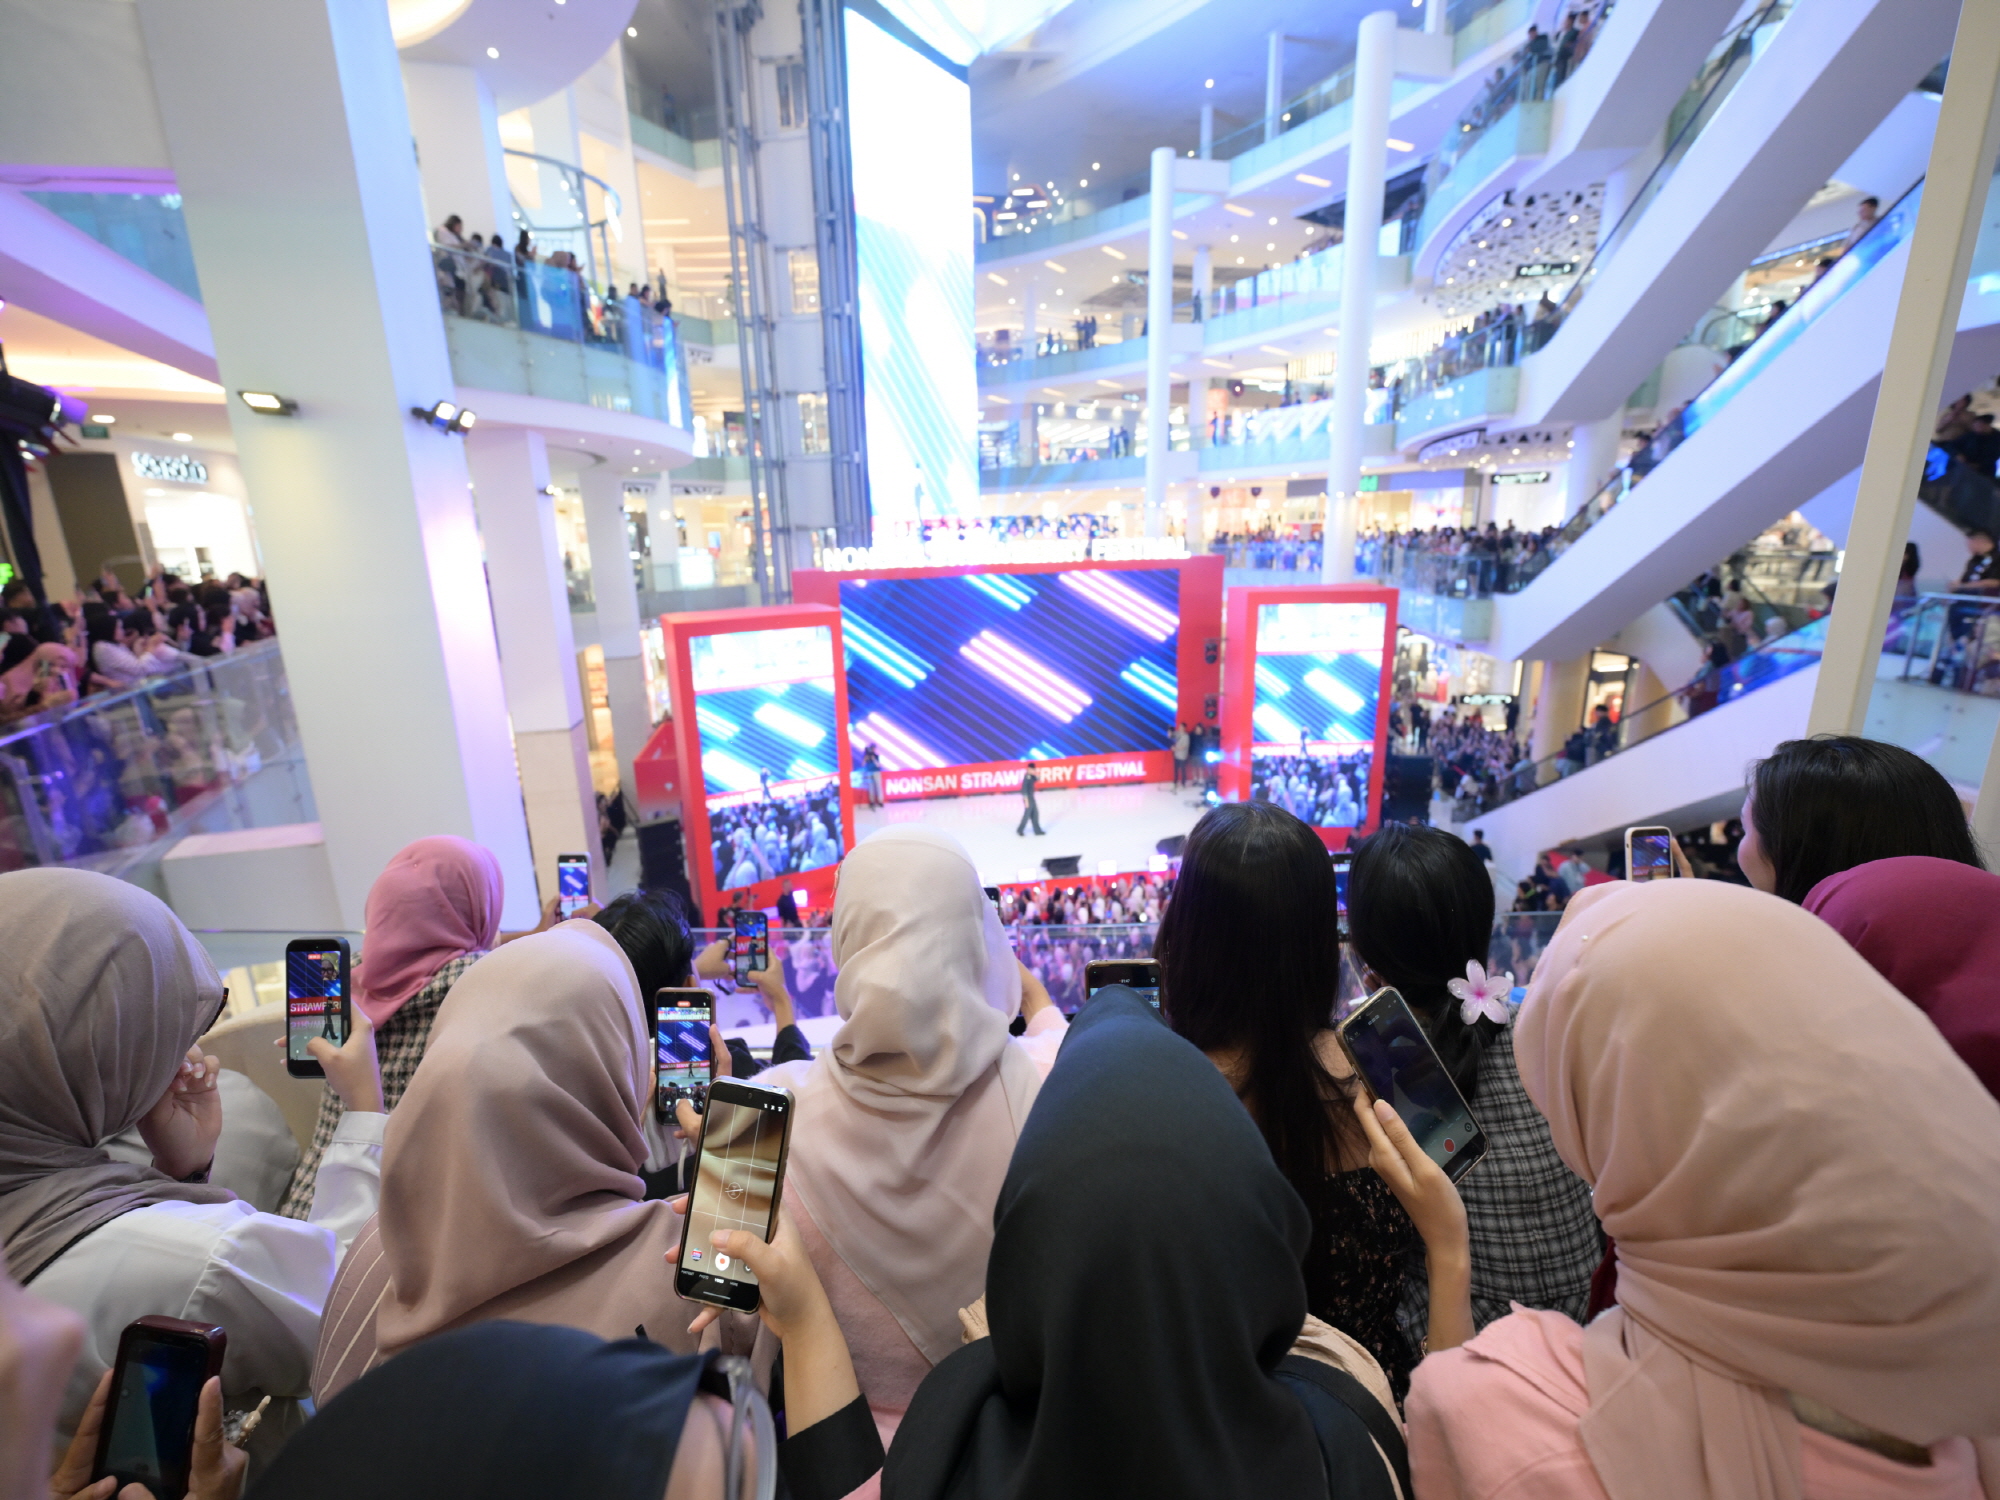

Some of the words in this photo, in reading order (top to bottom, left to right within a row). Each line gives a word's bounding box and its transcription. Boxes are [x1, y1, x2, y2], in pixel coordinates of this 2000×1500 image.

[886, 774, 957, 796] NONSAN
[961, 766, 1073, 789] STRAWRRY
[1076, 761, 1147, 781] FESTIVAL
